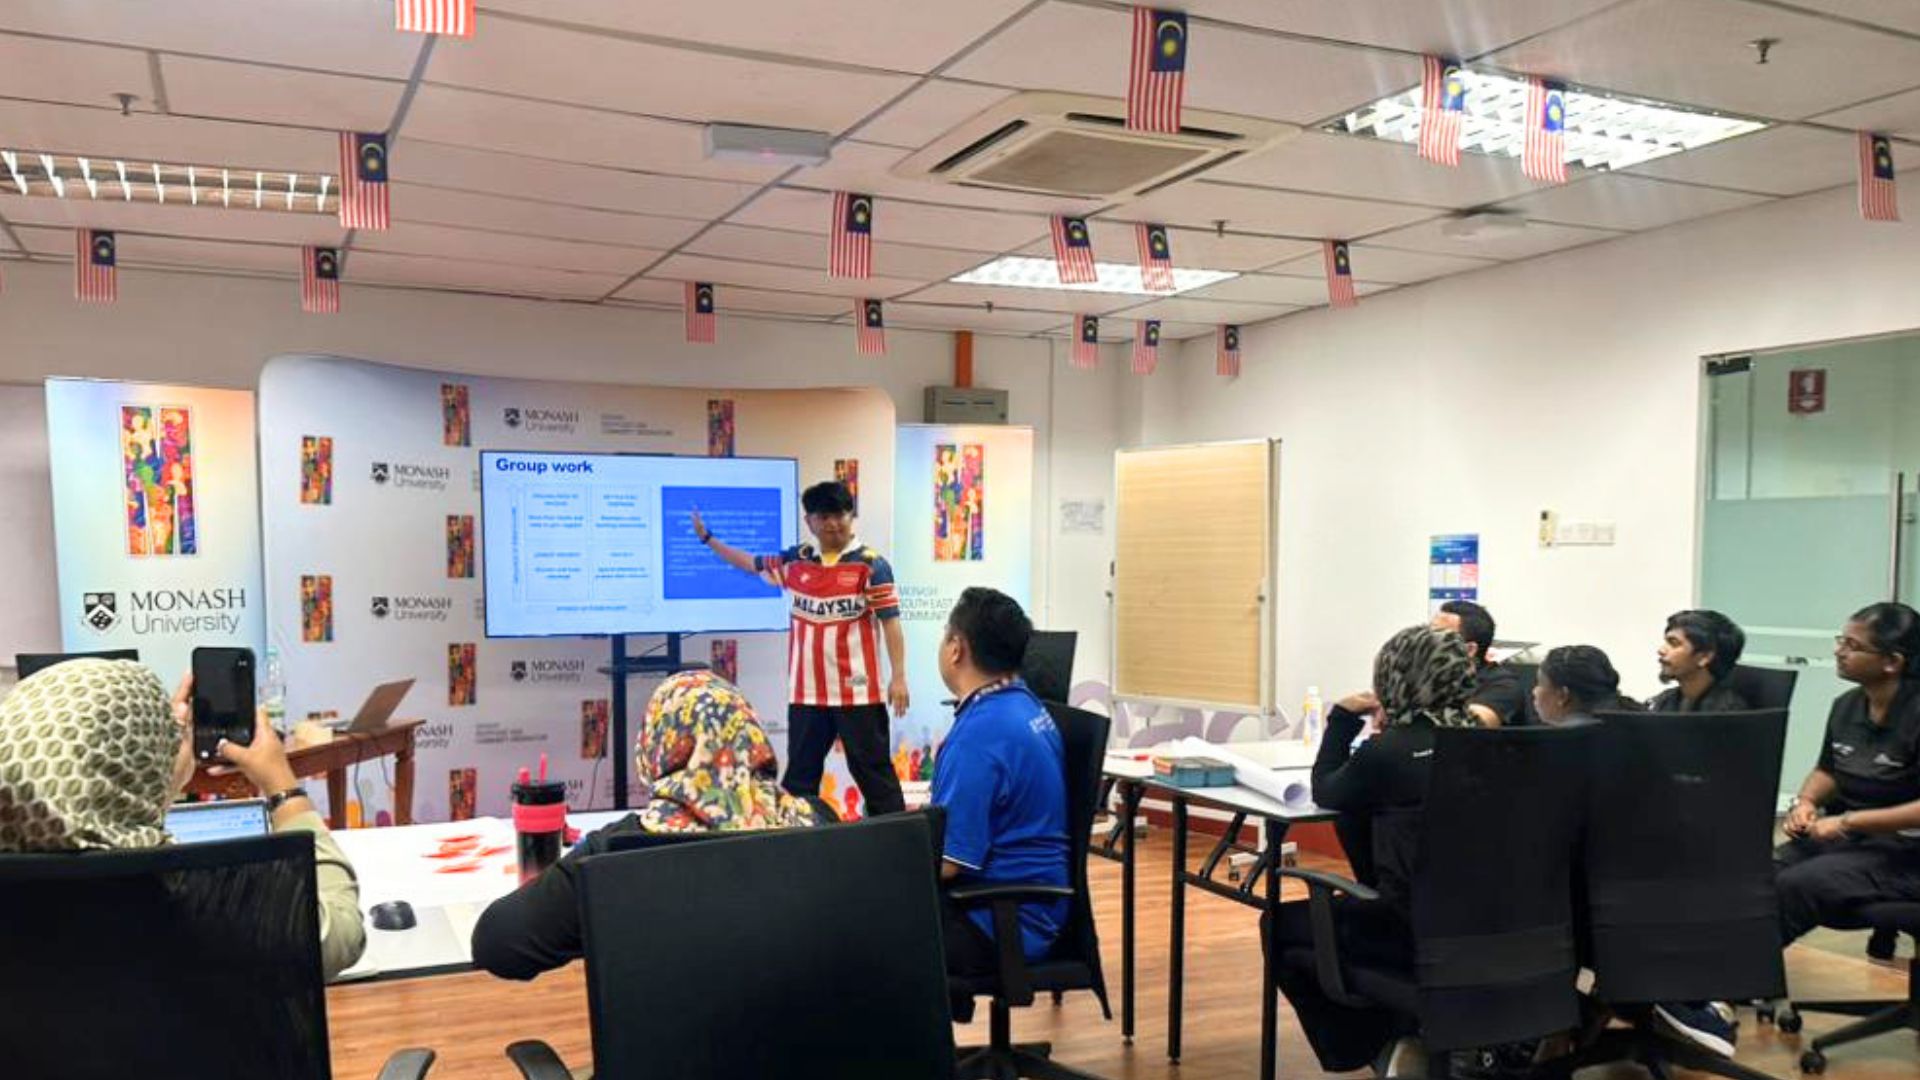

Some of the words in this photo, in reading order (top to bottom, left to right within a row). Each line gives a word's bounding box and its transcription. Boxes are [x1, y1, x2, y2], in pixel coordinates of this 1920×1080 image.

[525, 409, 579, 423] MONASH
[525, 421, 575, 435] University
[394, 463, 450, 479] MONASH
[496, 457, 547, 474] Group
[552, 460, 593, 473] work
[394, 476, 446, 491] University
[131, 588, 246, 612] MONASH
[394, 596, 451, 610] MONASH
[131, 610, 240, 635] University
[394, 609, 447, 622] University
[530, 659, 585, 672] MONASH
[530, 671, 581, 683] University
[415, 723, 453, 737] NASH
